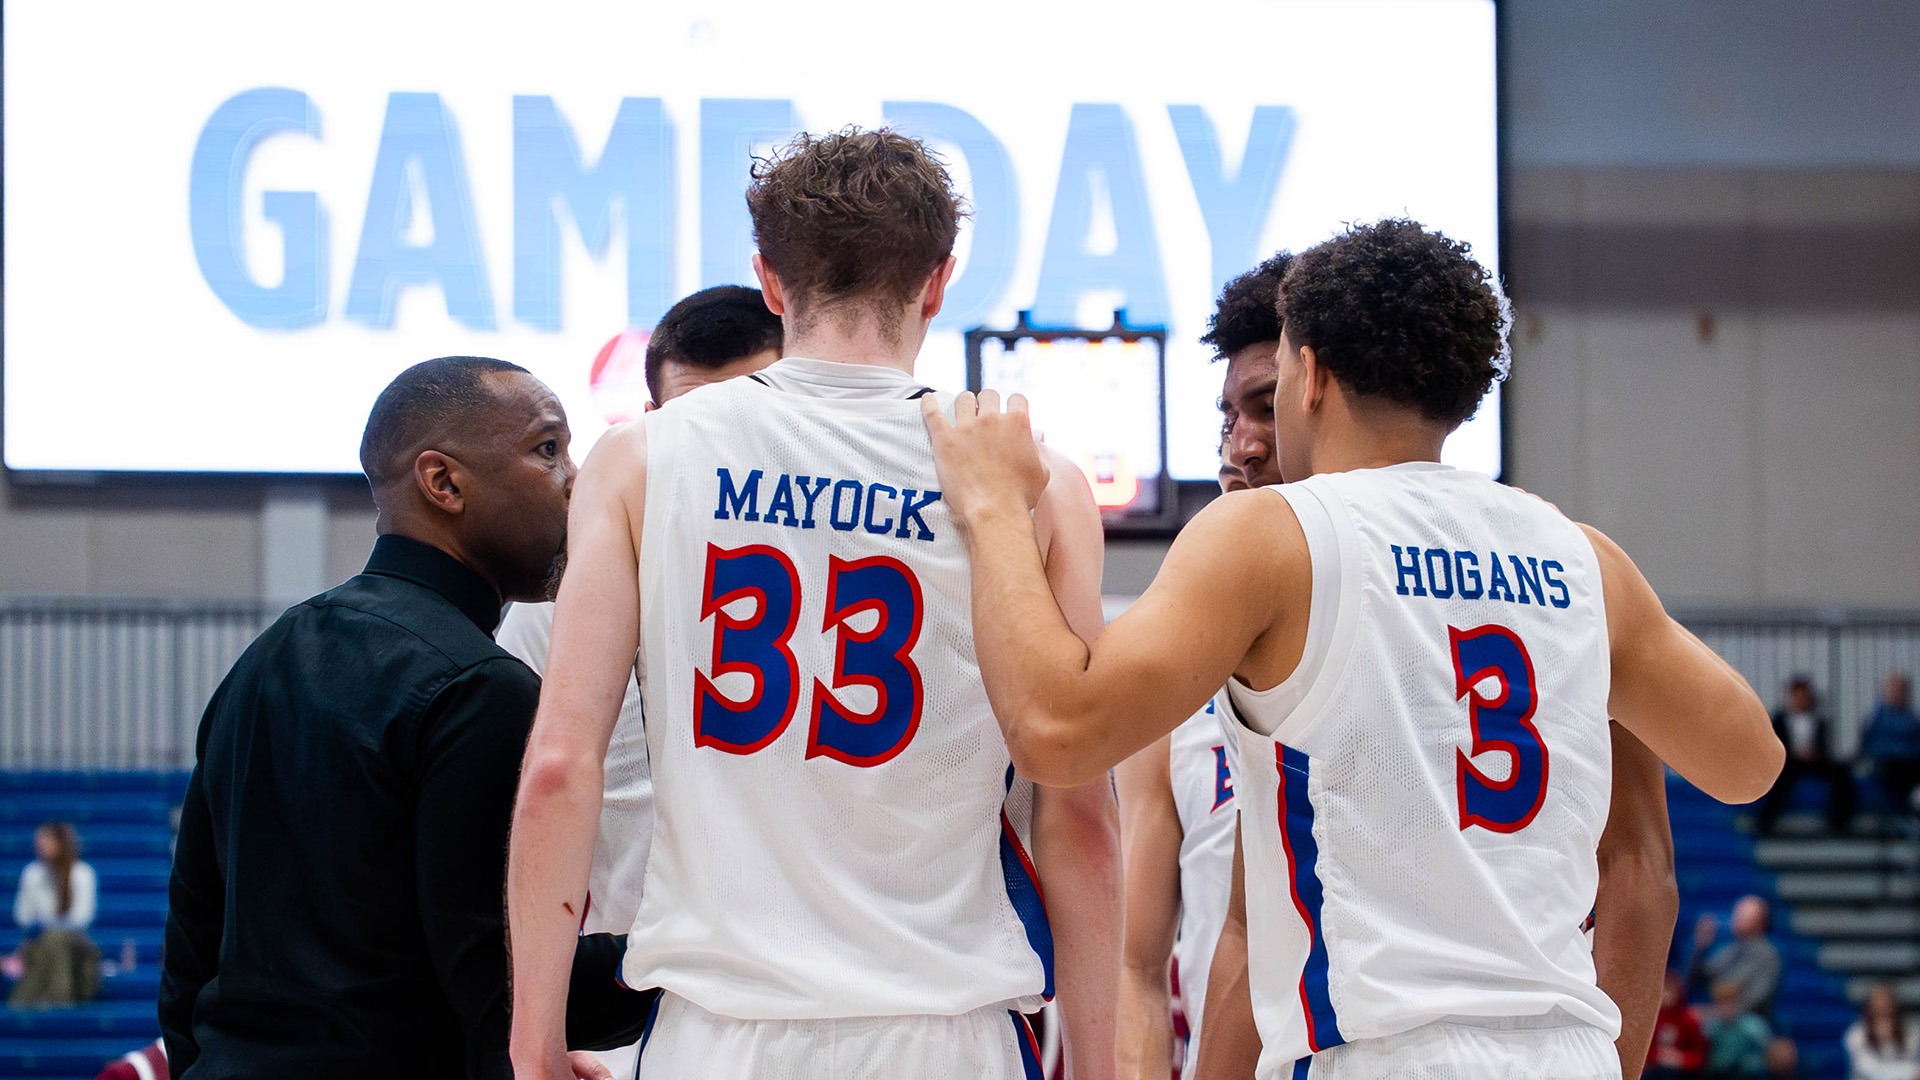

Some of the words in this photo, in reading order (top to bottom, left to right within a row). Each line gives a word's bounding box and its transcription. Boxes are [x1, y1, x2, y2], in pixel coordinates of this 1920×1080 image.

[881, 100, 1300, 334] DAY
[714, 467, 942, 542] MAYOCK
[1390, 544, 1571, 609] HOGANS
[693, 541, 925, 768] 33
[1447, 623, 1550, 834] 3
